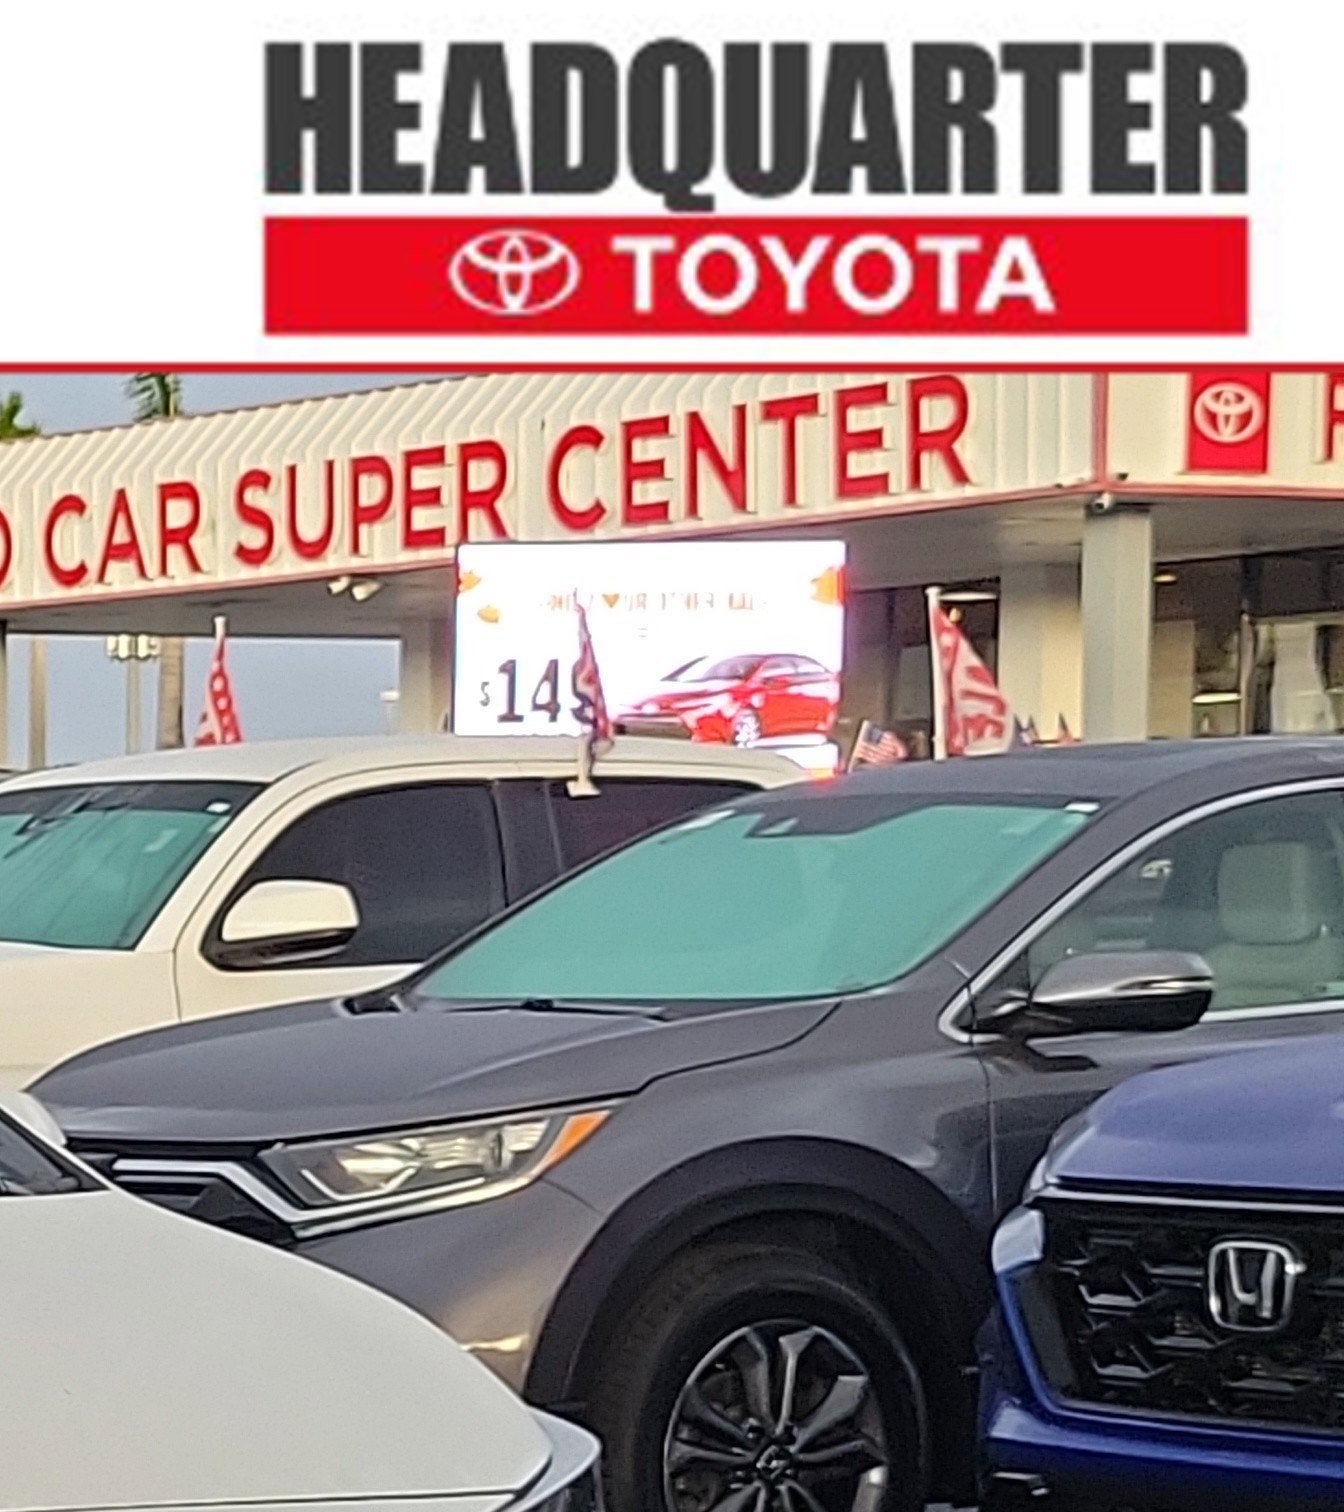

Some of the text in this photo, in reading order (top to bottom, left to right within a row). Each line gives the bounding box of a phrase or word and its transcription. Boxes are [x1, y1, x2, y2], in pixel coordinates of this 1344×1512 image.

[43, 481, 203, 589] CAR
[233, 438, 510, 567] SUPER
[546, 374, 971, 532] CENTER
